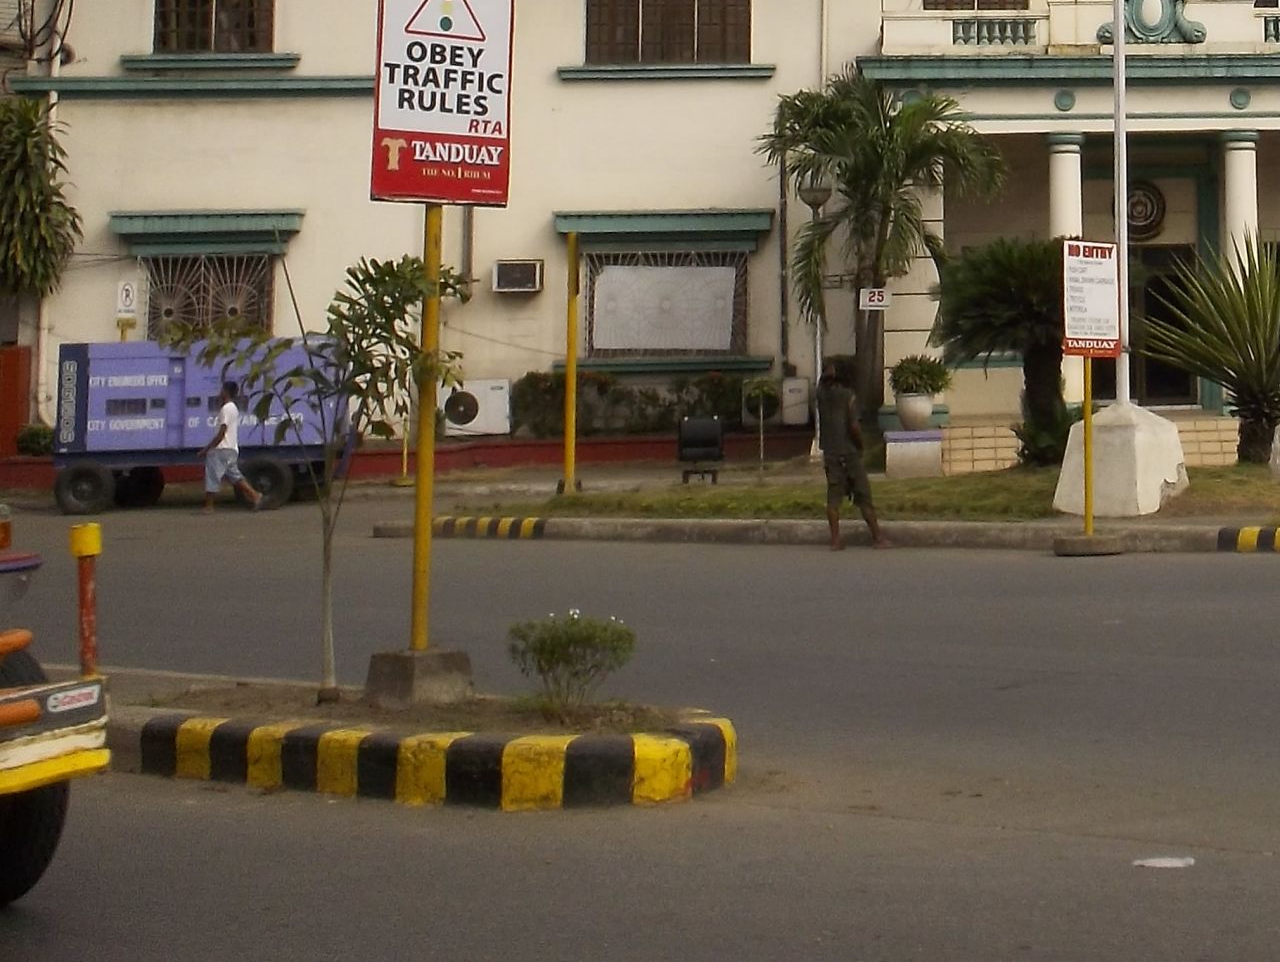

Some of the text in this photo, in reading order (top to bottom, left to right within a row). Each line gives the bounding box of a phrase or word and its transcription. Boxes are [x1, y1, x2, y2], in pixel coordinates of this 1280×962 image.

[406, 41, 485, 69] OBEY
[384, 62, 504, 94] TRAFFIC
[398, 88, 489, 116] RULES
[468, 118, 502, 135] RTA
[411, 140, 504, 165] TANDUAY
[1068, 243, 1115, 260] NO ENTRY
[868, 290, 885, 303] 25
[1067, 339, 1117, 349] TANDUAY
[89, 377, 105, 388] CITY
[88, 420, 105, 432] CITY
[109, 418, 165, 431] GOVERNMENT
[188, 417, 200, 428] OF
